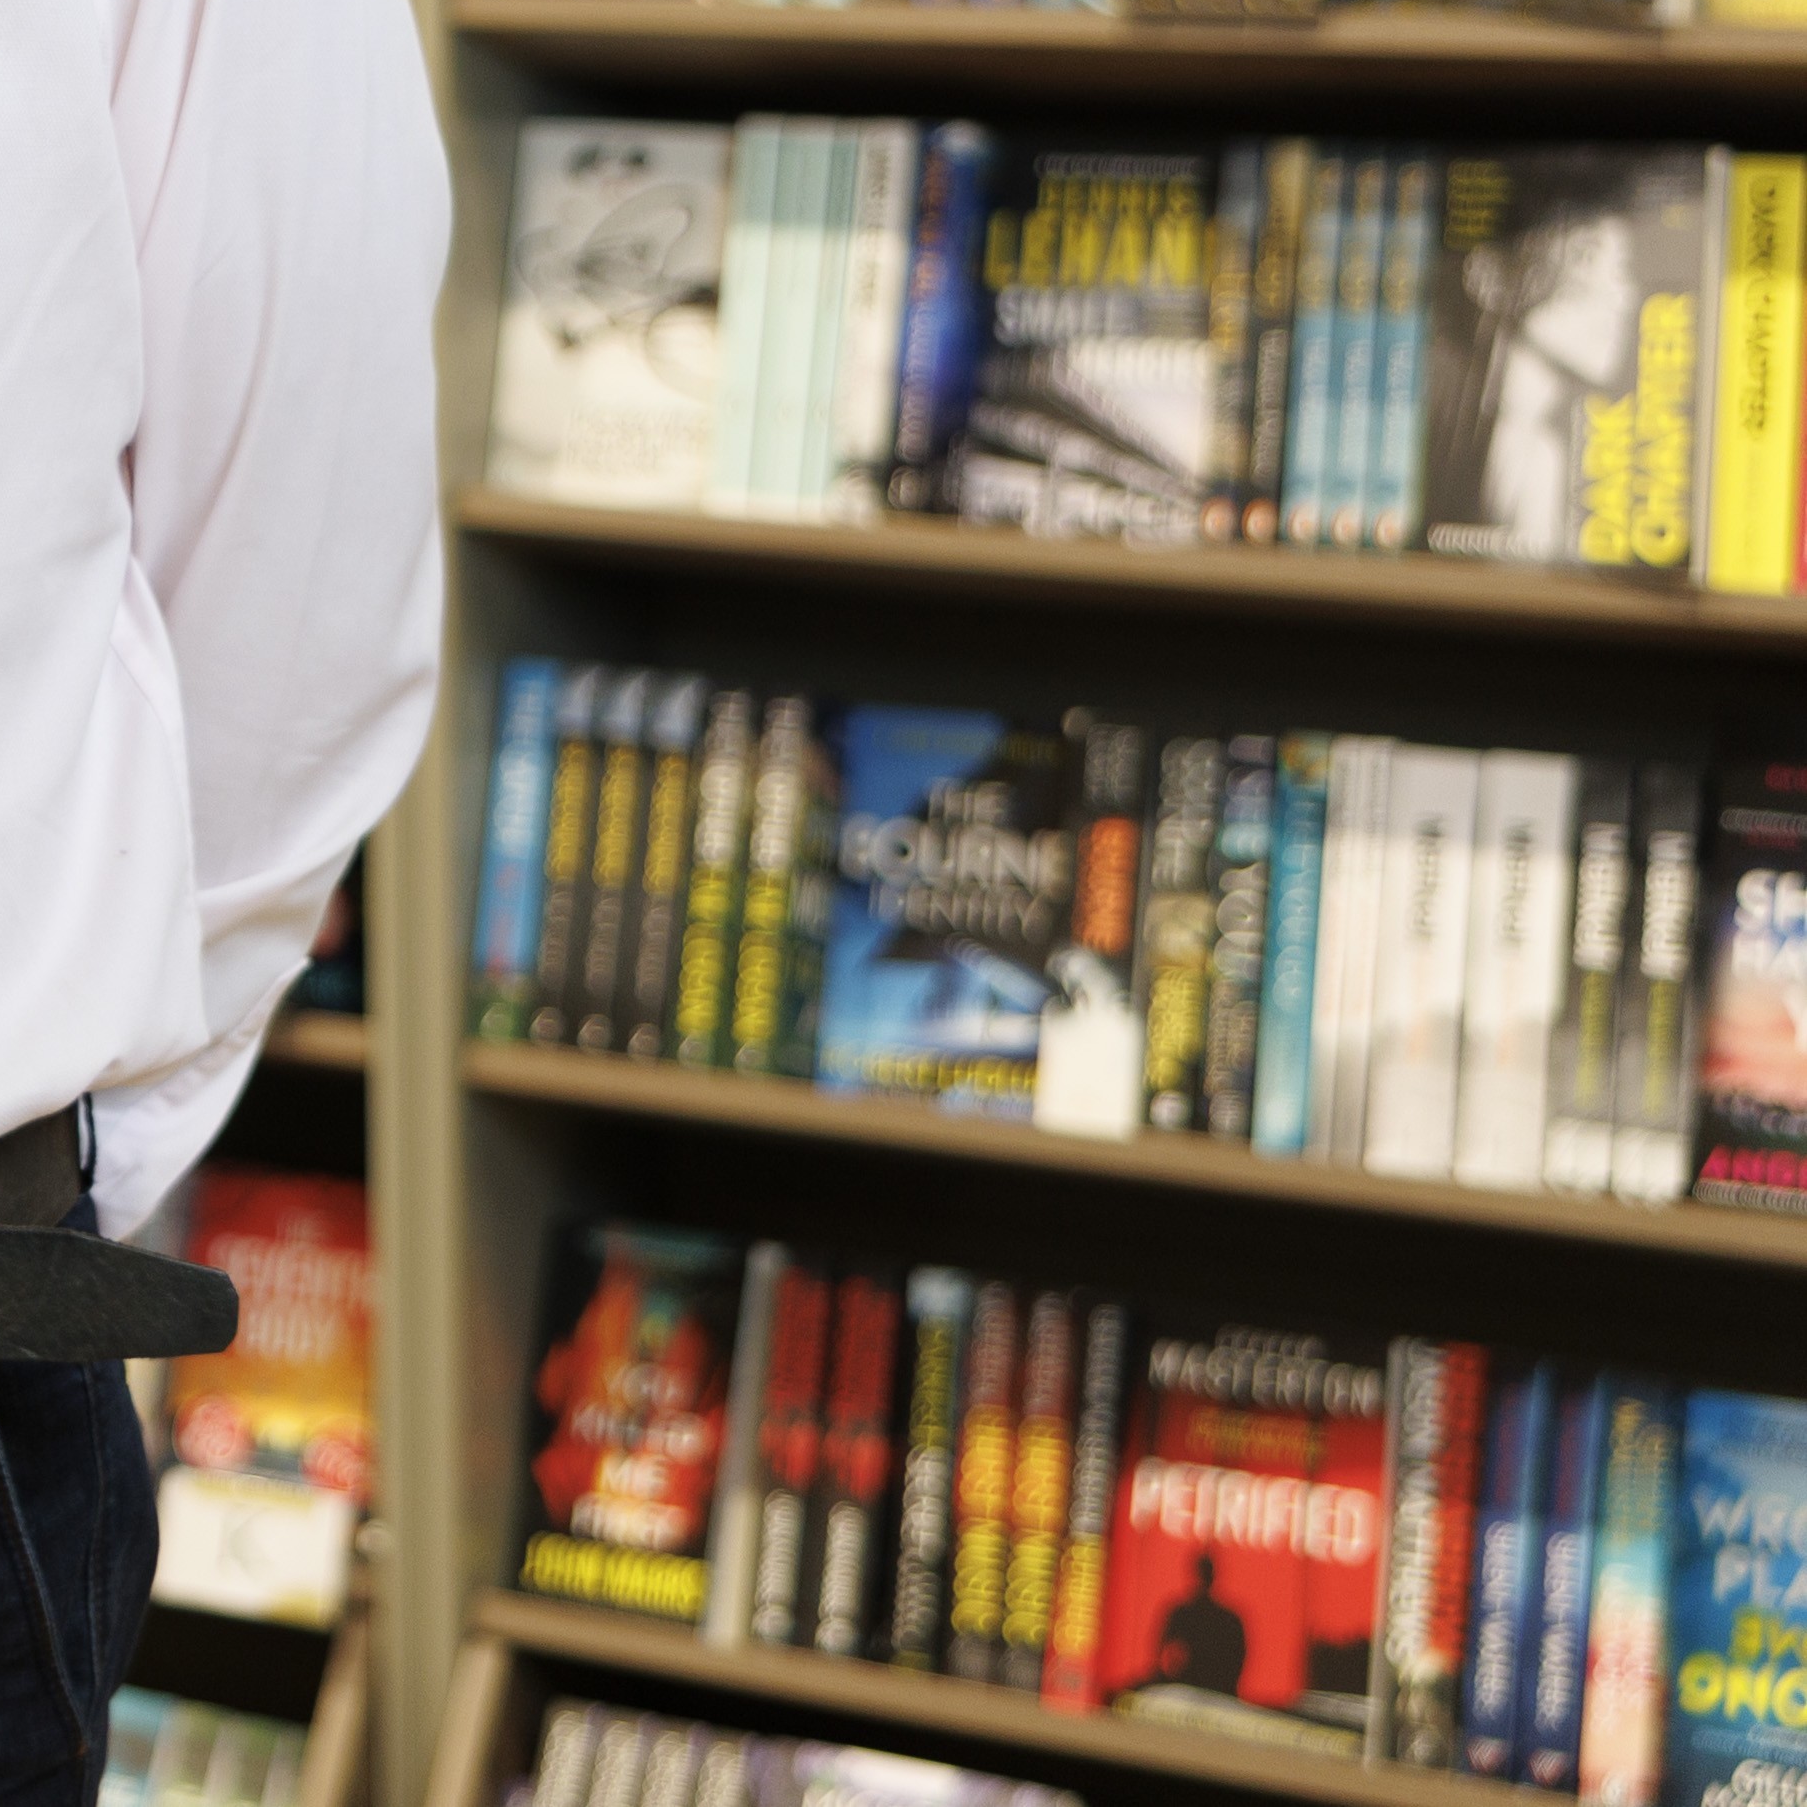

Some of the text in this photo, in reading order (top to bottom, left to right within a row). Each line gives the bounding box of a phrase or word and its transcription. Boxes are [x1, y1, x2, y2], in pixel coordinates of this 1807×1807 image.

[1578, 291, 1693, 568] DARK CHAPTER
[838, 812, 1077, 887] BOURNE
[1149, 1336, 1384, 1418] MASTERTON
[598, 1450, 671, 1500] ME
[1130, 1454, 1377, 1566] PETRIFIED
[521, 1531, 607, 1595] JOHN
[1387, 1458, 1442, 1670] MATTHEWS
